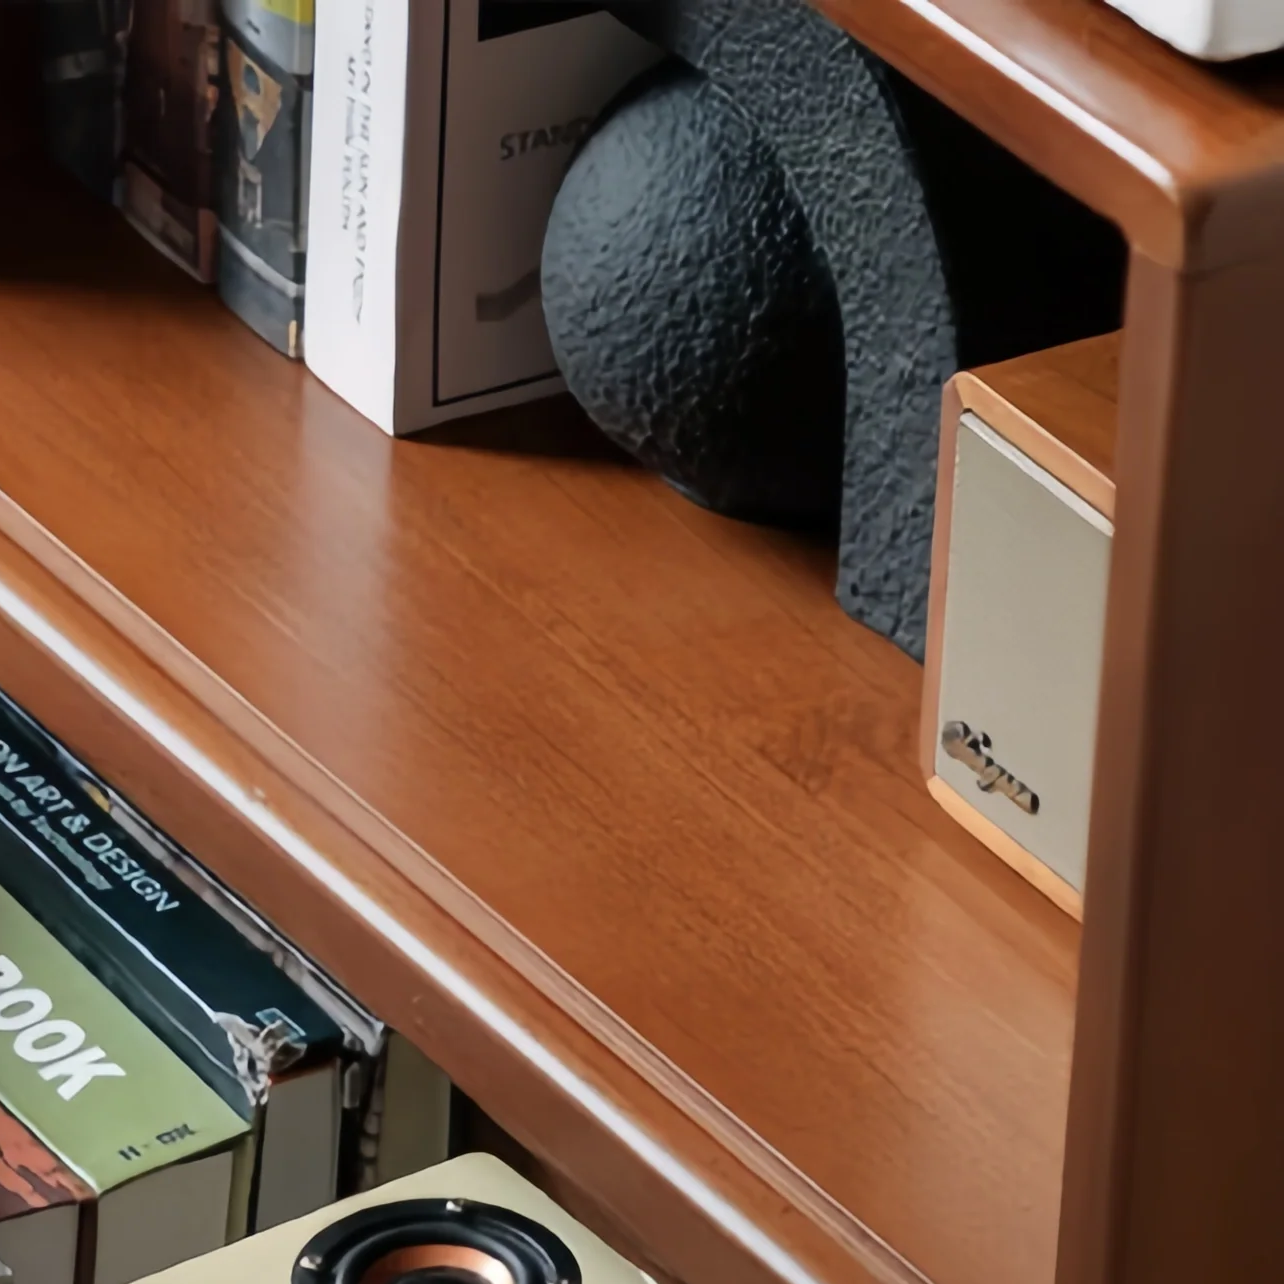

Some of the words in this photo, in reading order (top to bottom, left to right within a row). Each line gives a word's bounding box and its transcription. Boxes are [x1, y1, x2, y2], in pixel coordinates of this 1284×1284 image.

[15, 775, 74, 812] ART
[61, 813, 90, 834] &
[83, 832, 180, 912] DESIGN
